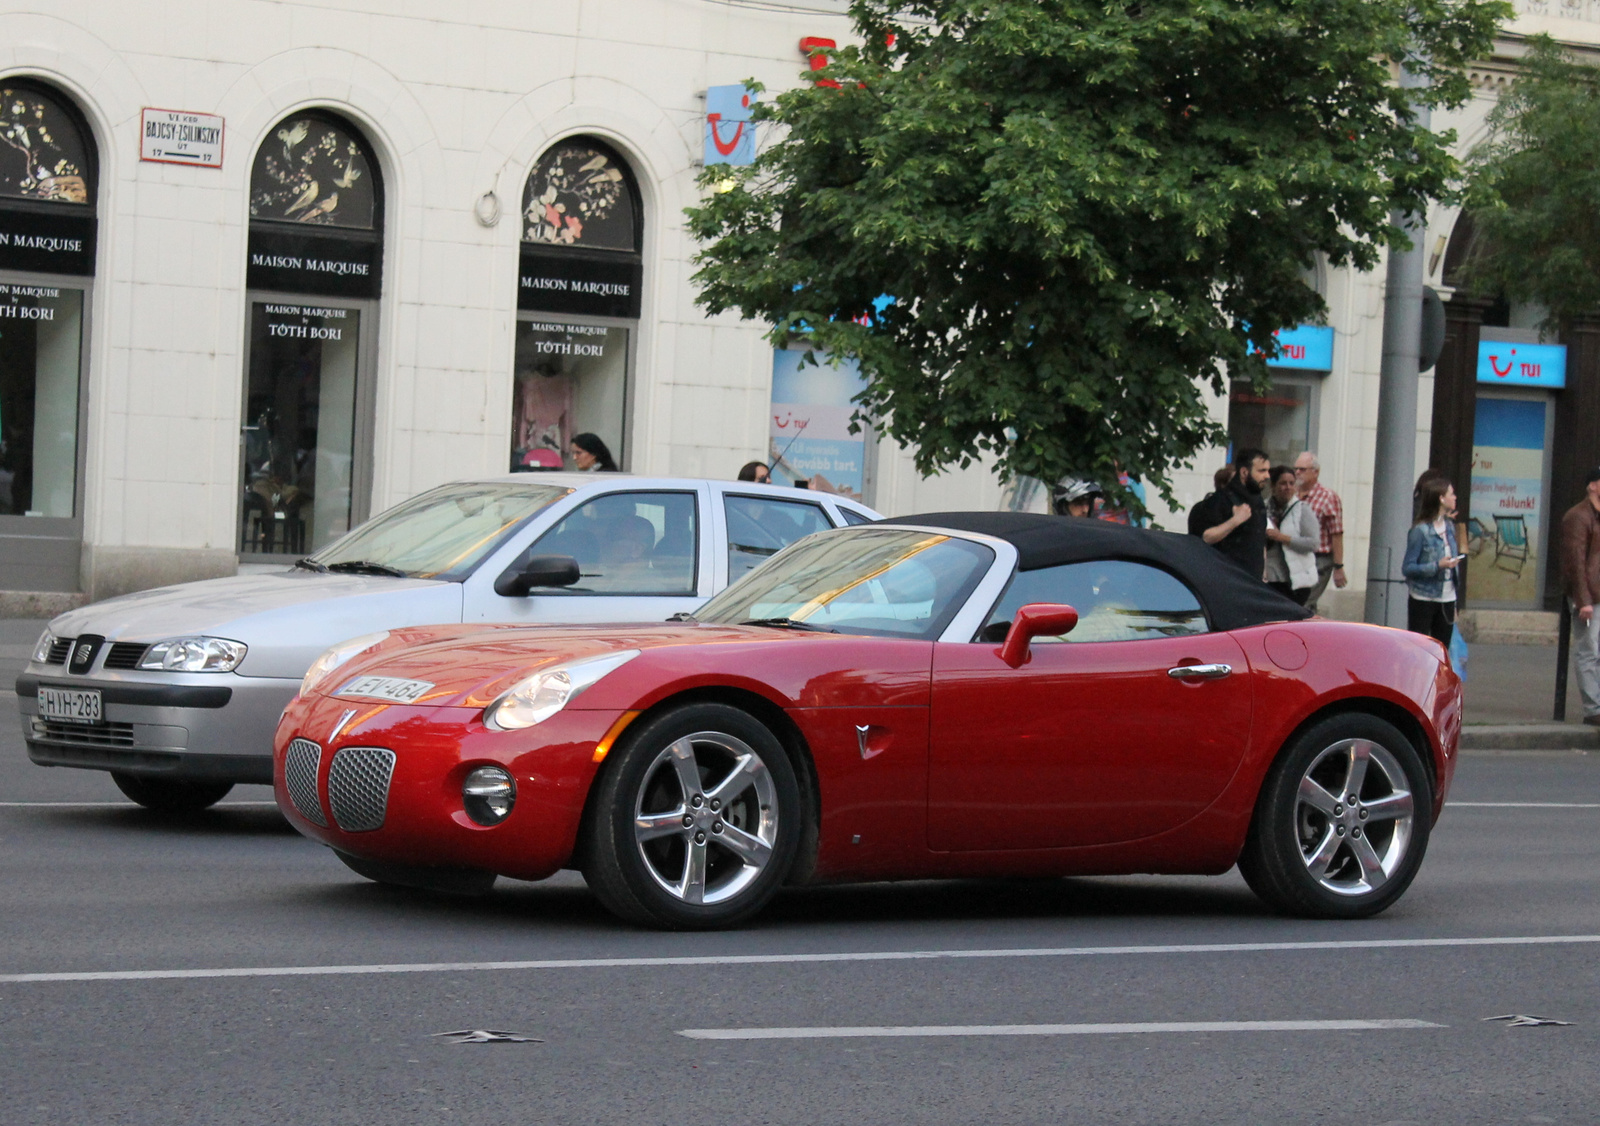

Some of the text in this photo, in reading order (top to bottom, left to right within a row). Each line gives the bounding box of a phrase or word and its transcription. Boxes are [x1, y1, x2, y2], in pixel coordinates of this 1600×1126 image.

[14, 234, 82, 252] MARQUISE
[252, 254, 369, 275] MAISON MARQUISE
[12, 286, 60, 298] MARQUISE
[521, 277, 630, 296] MAISON MARQUISE
[12, 296, 19, 304] by
[20, 306, 54, 320] BORI
[265, 304, 347, 319] MAISON MARQUISE
[302, 317, 309, 325] by
[310, 328, 342, 340] BORI
[532, 323, 608, 336] MAISON MARQUISE
[574, 344, 603, 356] BORI
[1283, 345, 1305, 359] TUI
[1520, 363, 1541, 377] TUI
[794, 420, 807, 429] TUI
[794, 457, 857, 472] tovább tart.
[1499, 495, 1535, 509] nálunk!
[345, 678, 428, 699] LEV-464
[47, 691, 99, 717] HIH-283
